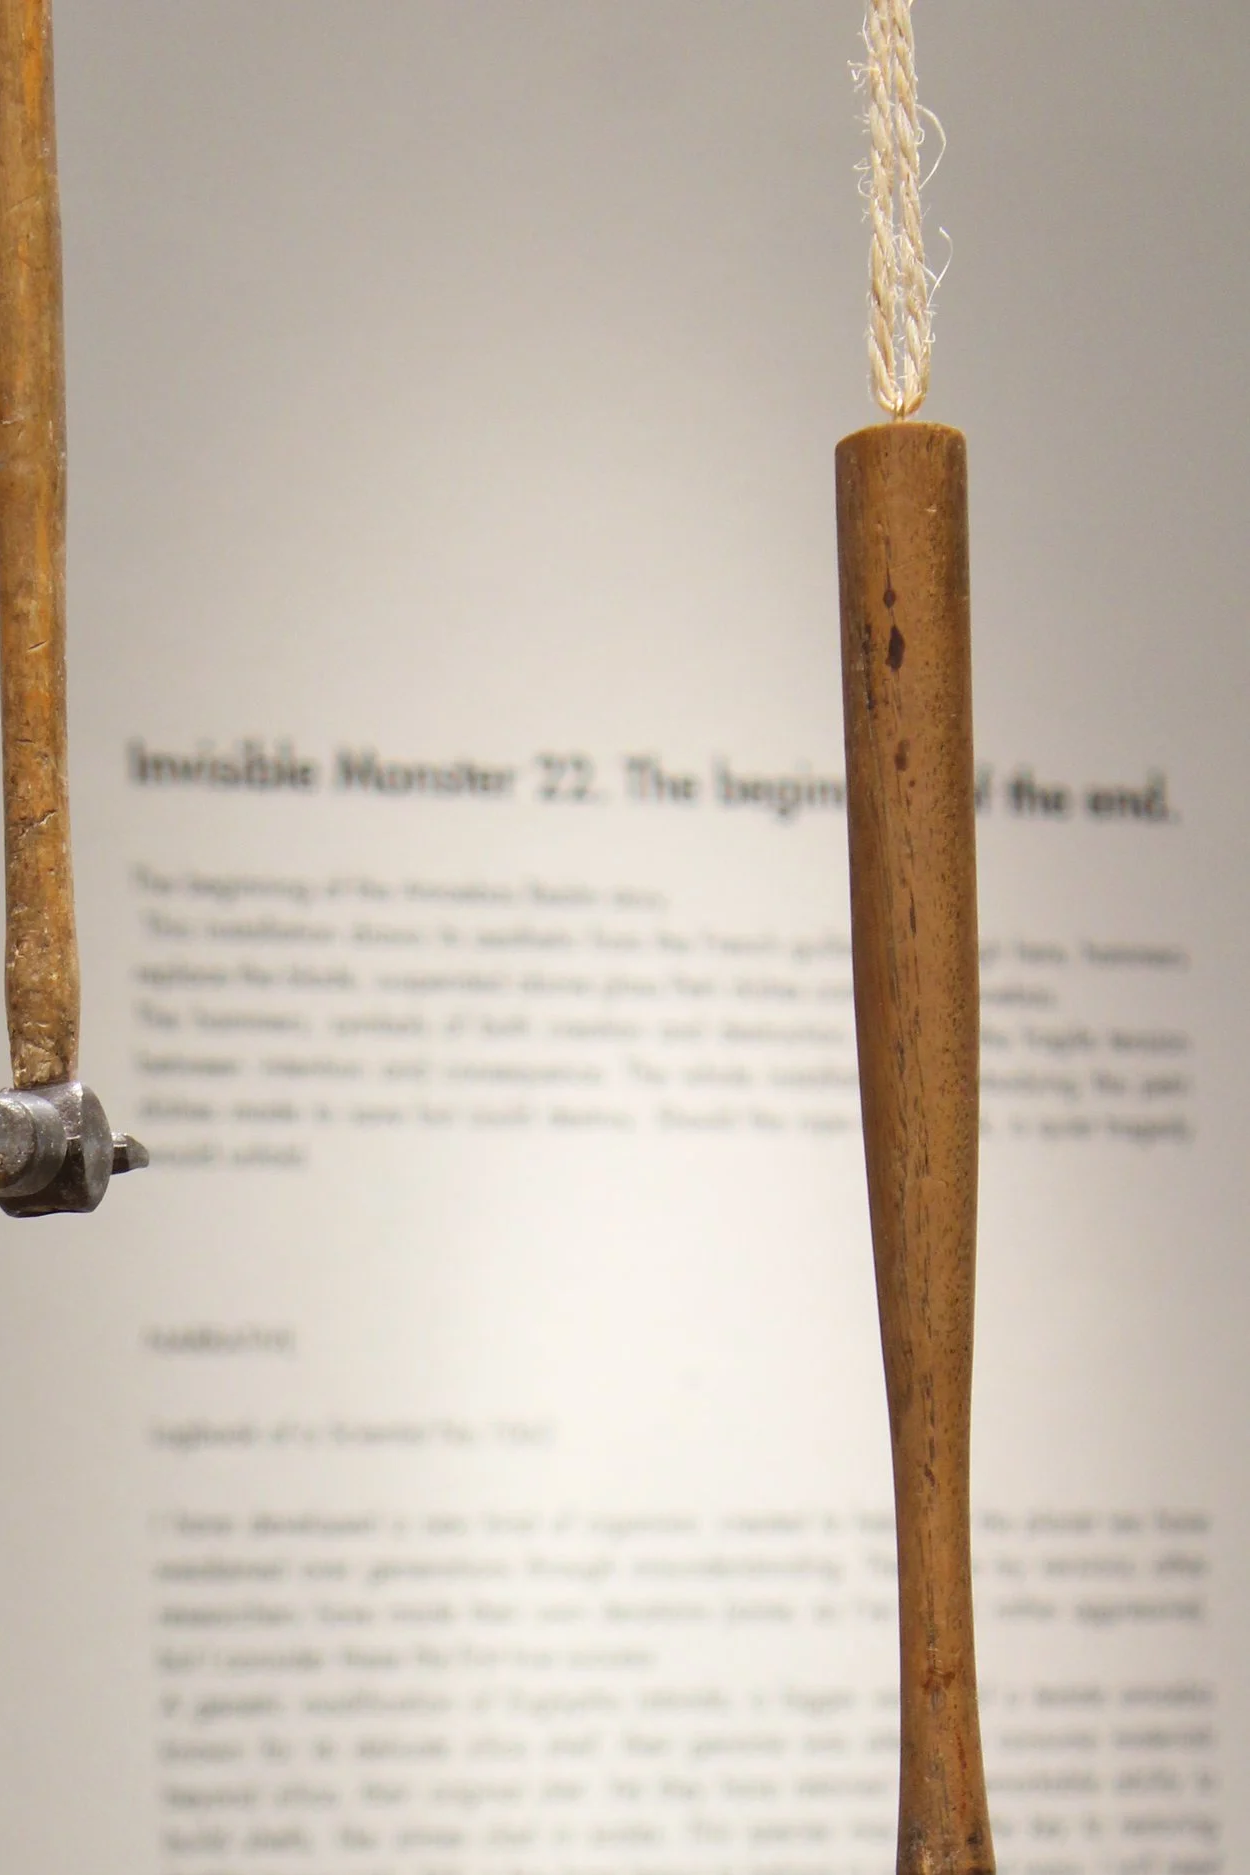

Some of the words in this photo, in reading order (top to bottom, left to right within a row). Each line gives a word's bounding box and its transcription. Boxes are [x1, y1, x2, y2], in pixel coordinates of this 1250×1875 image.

[128, 735, 318, 792] Invisible
[336, 744, 516, 797] Monster
[623, 752, 699, 804] The
[1008, 764, 1071, 820] the
